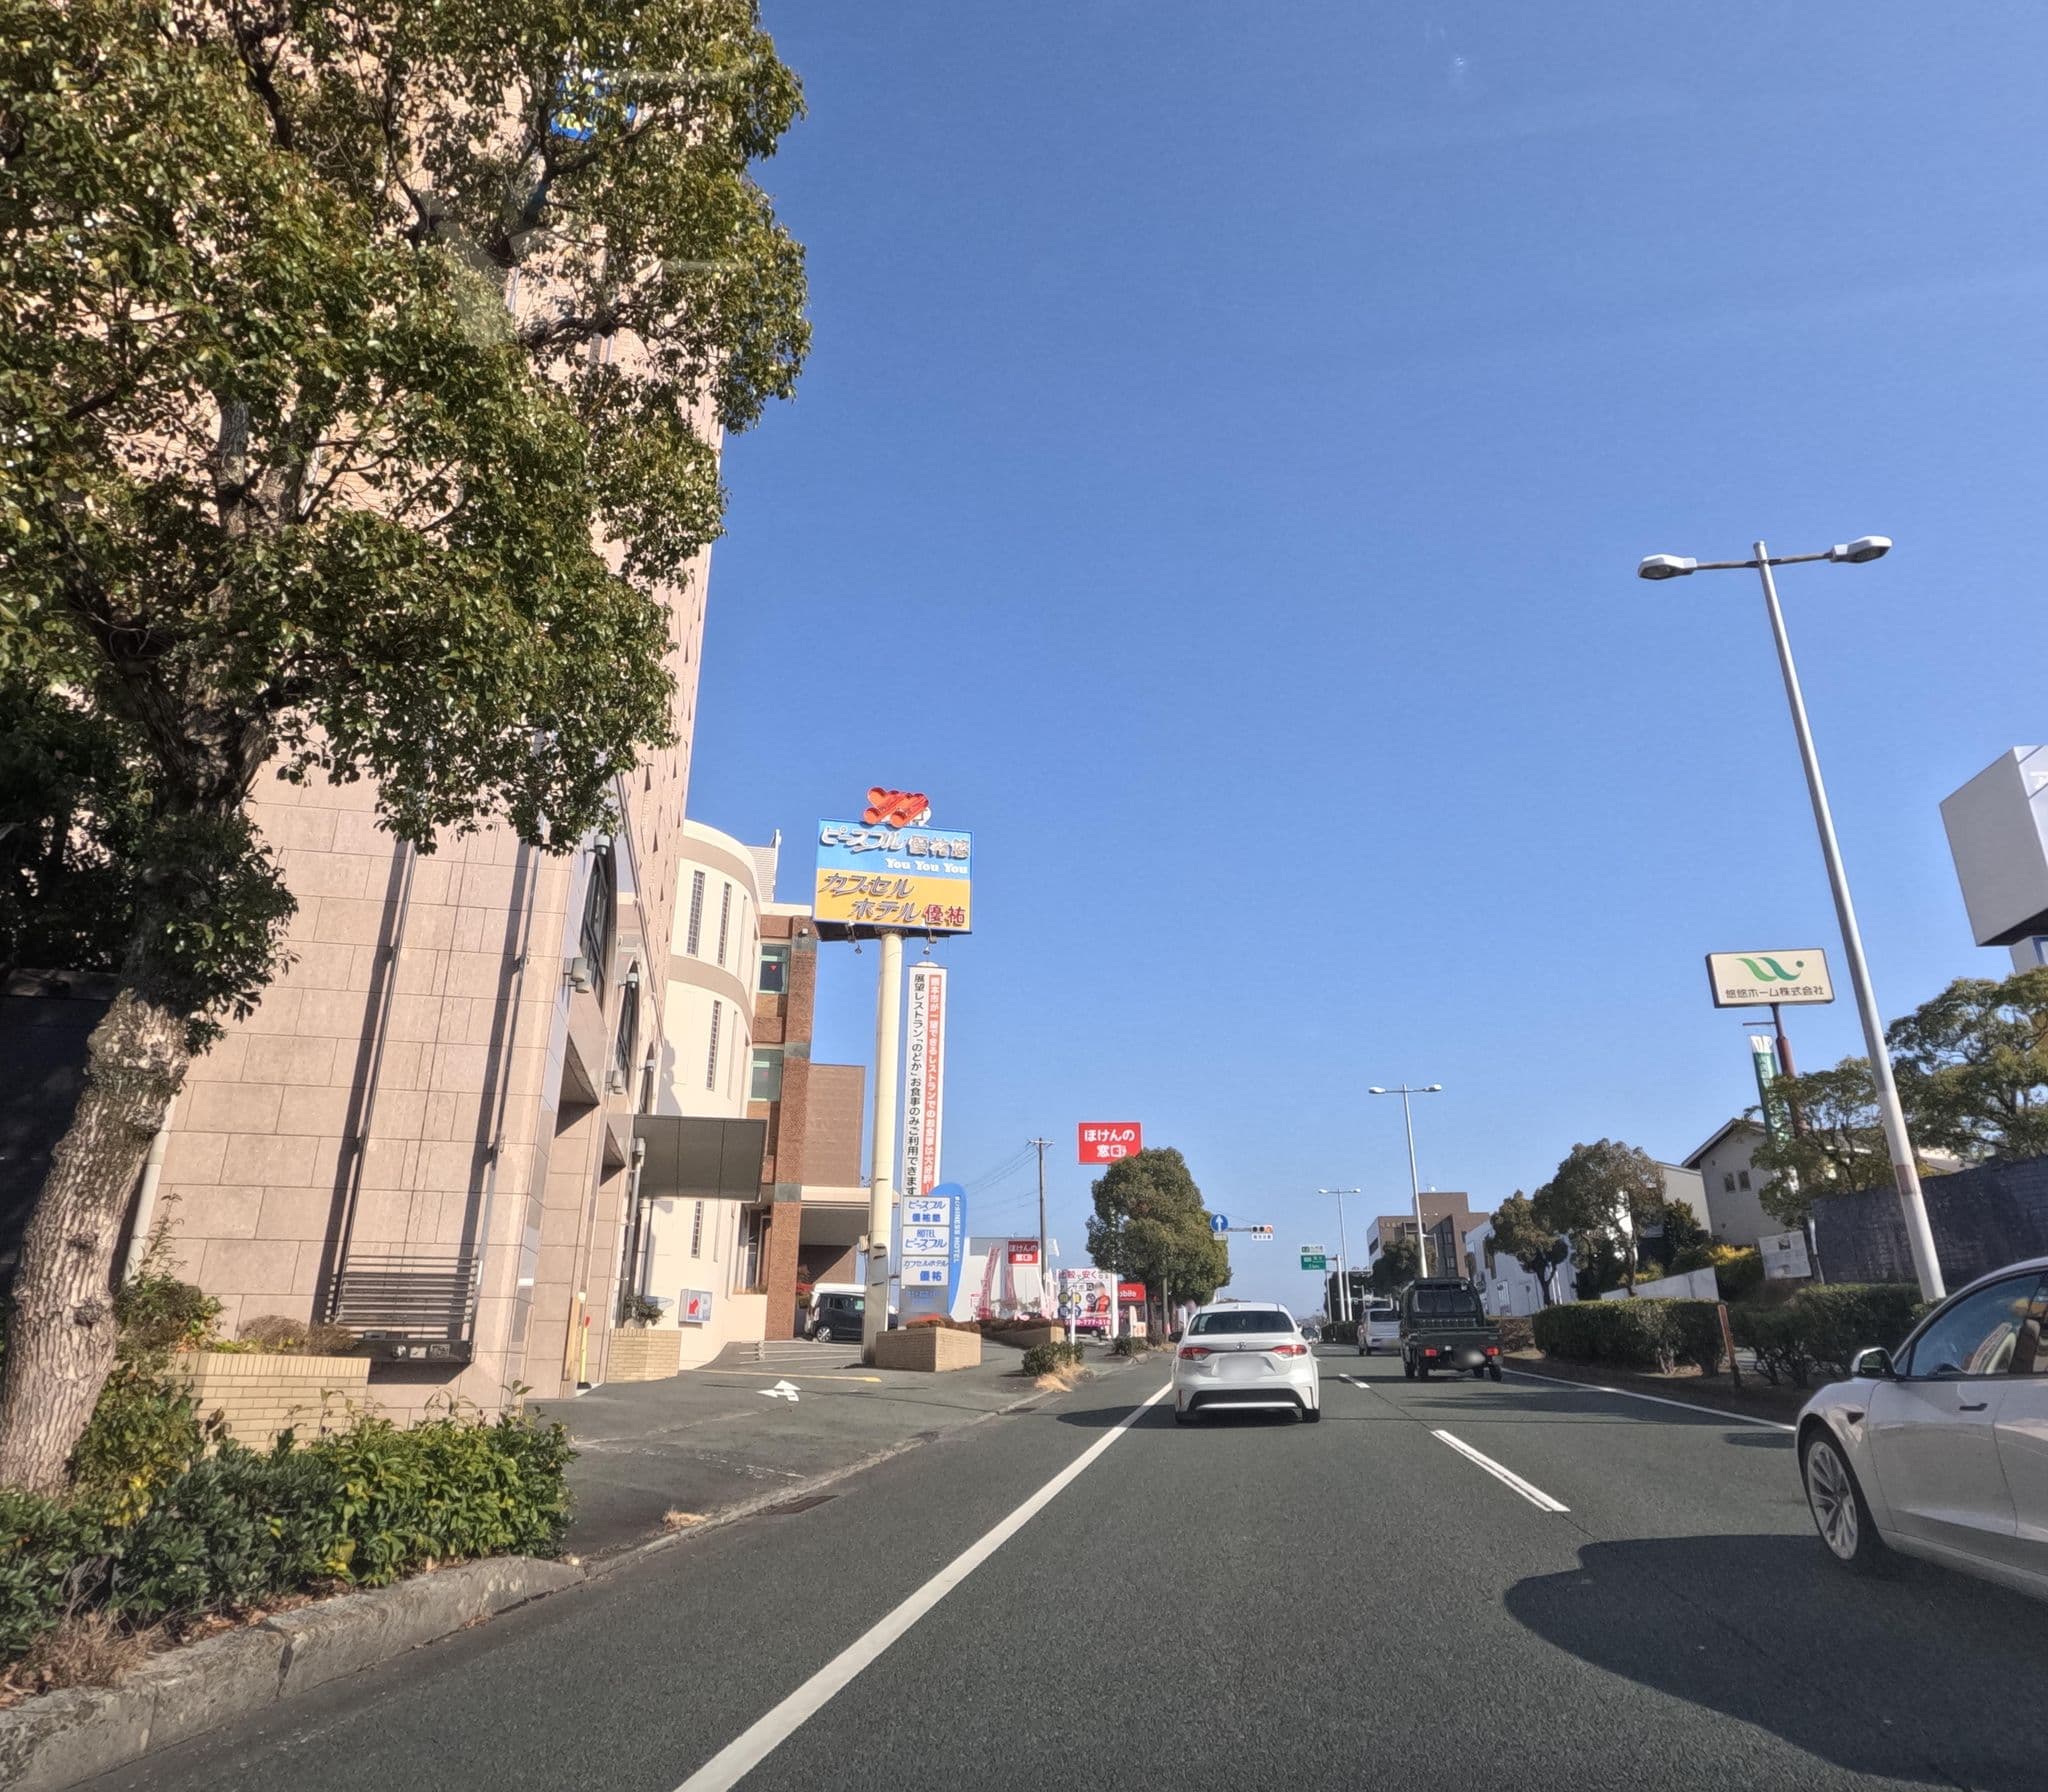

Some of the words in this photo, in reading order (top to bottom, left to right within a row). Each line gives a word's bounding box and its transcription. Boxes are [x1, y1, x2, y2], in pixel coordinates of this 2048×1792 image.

[885, 857, 911, 870] You
[915, 860, 940, 872] You
[943, 862, 969, 875] You
[818, 872, 915, 899] カプセル
[1084, 1129, 1136, 1142] ほけんの
[1096, 1144, 1127, 1158] 窓口
[908, 1200, 946, 1212] ピースフル
[916, 1229, 936, 1238] HOTEL
[905, 1238, 948, 1251] ピースフル
[953, 1237, 961, 1263] HOTEL
[1009, 1244, 1038, 1253] ほけんの
